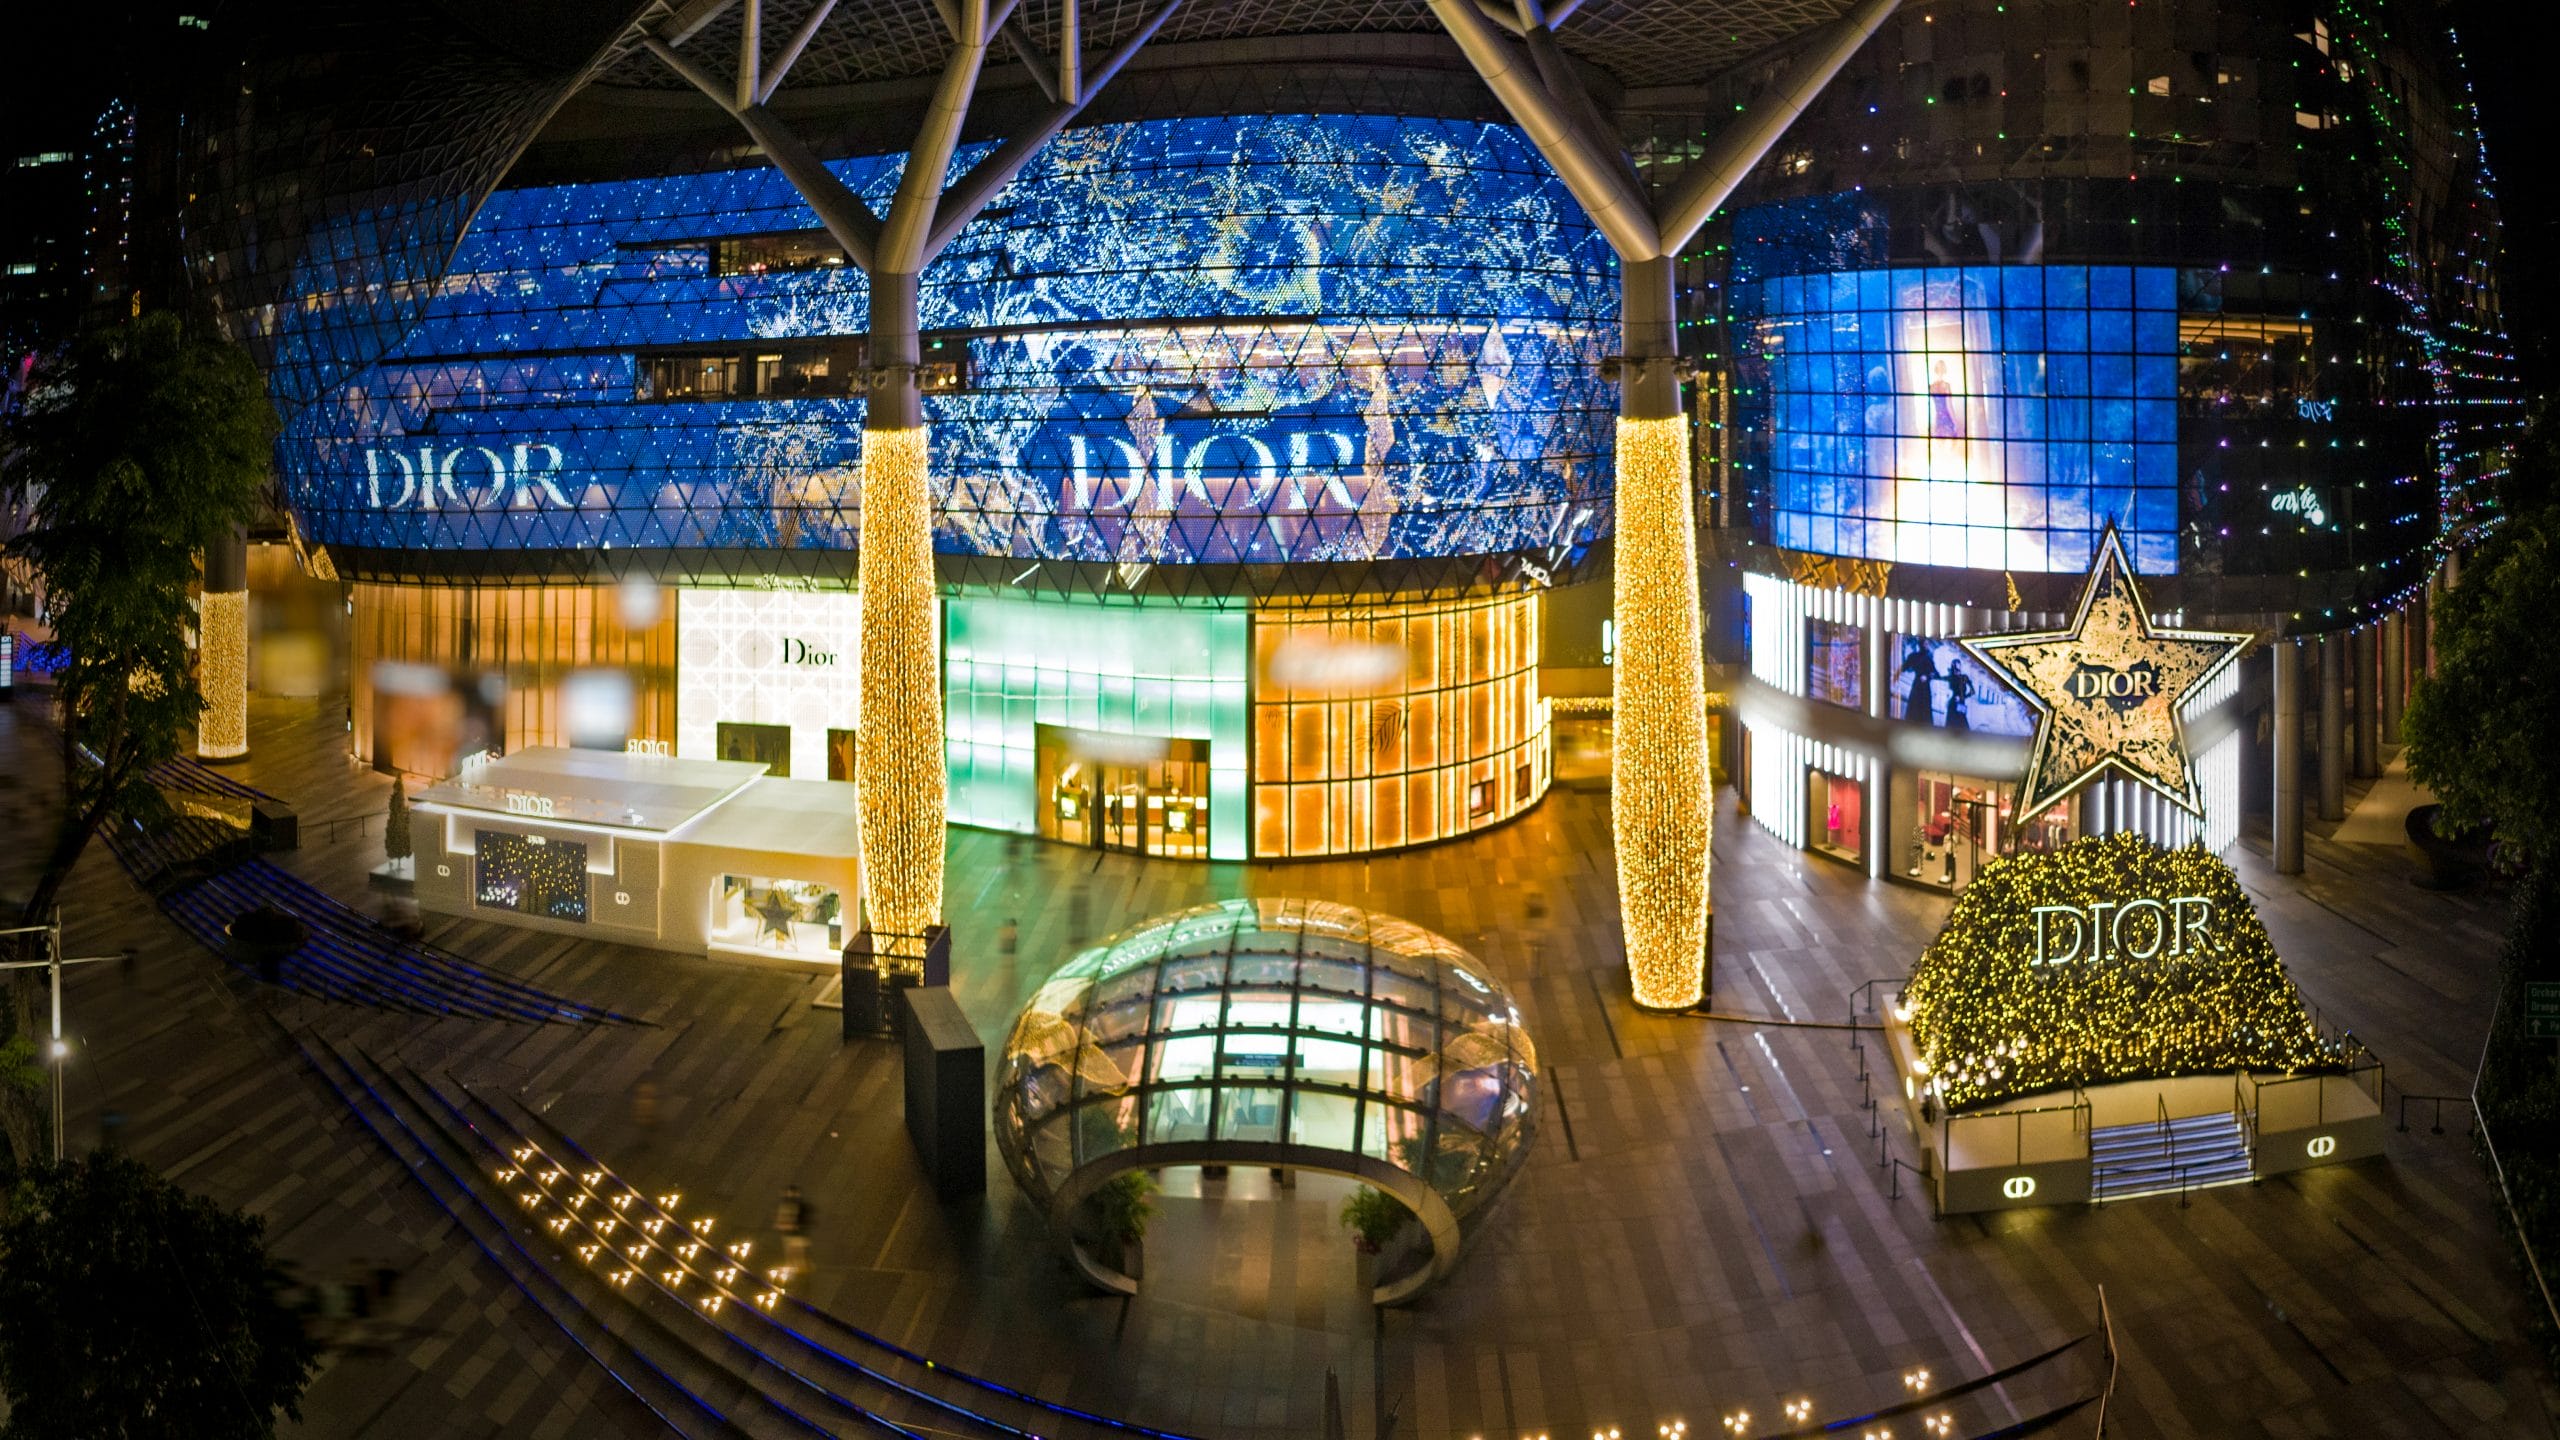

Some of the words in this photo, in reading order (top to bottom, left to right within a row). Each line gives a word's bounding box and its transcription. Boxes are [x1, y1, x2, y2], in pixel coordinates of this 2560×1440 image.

[365, 442, 574, 511] DIOR
[1069, 432, 1358, 512] DIOR
[784, 637, 838, 665] Dior
[2077, 669, 2156, 698] DIOR
[505, 793, 554, 818] DIOR
[2029, 896, 2226, 967] DIOR
